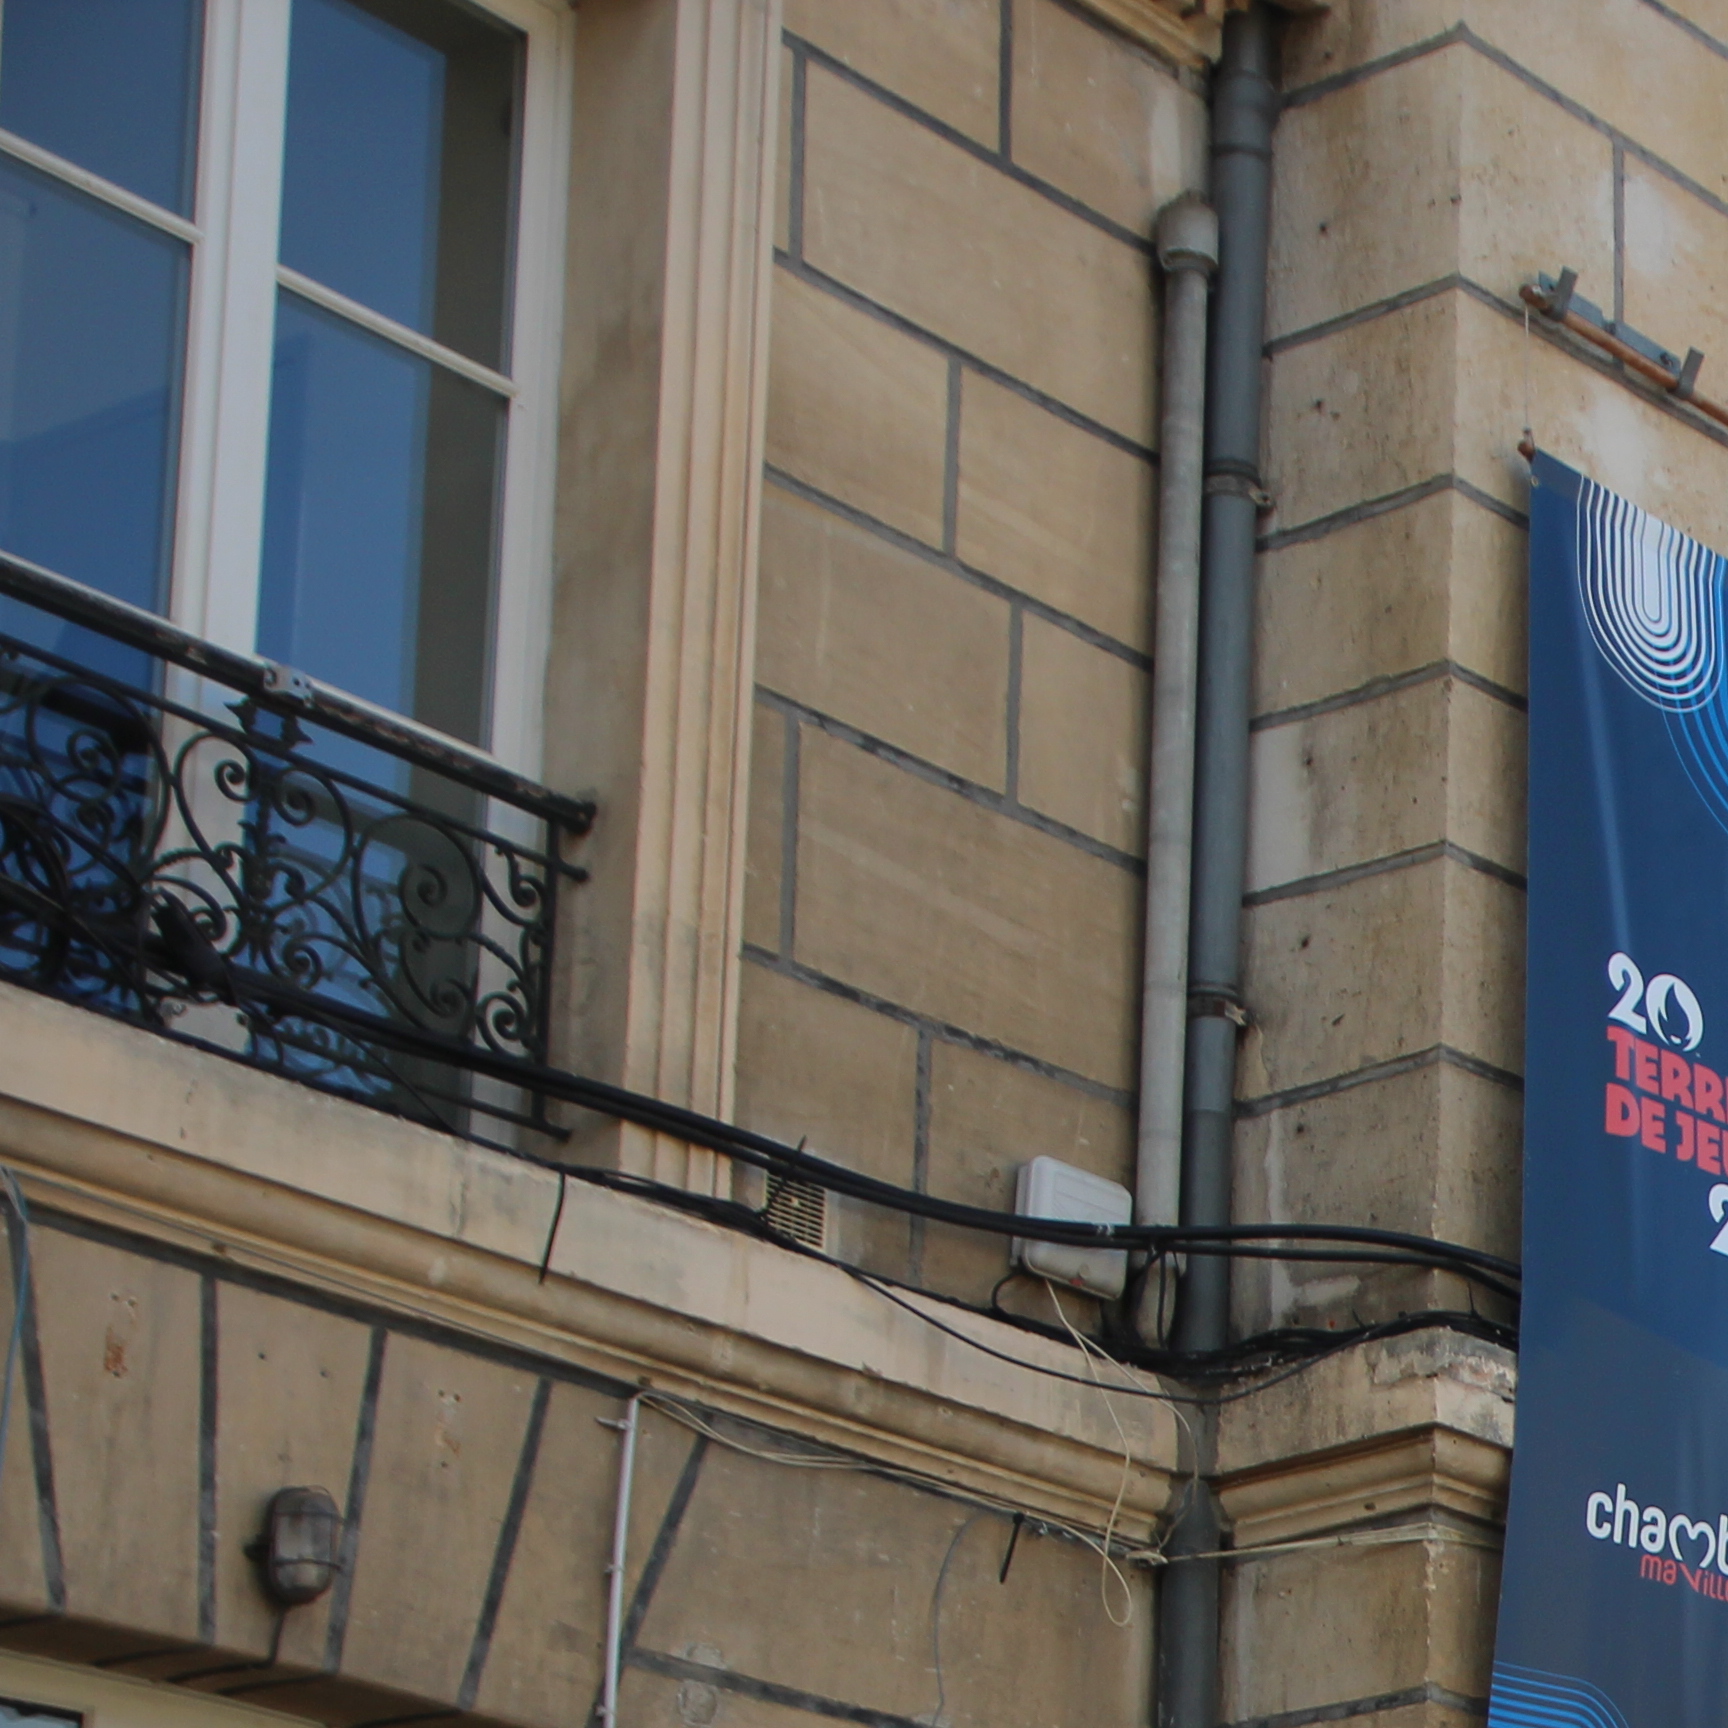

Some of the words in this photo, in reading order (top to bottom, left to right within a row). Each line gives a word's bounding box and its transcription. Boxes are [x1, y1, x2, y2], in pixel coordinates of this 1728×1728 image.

[1608, 952, 1704, 1052] 20
[1605, 1082, 1666, 1153] DE
[1640, 1553, 1677, 1586] ma
